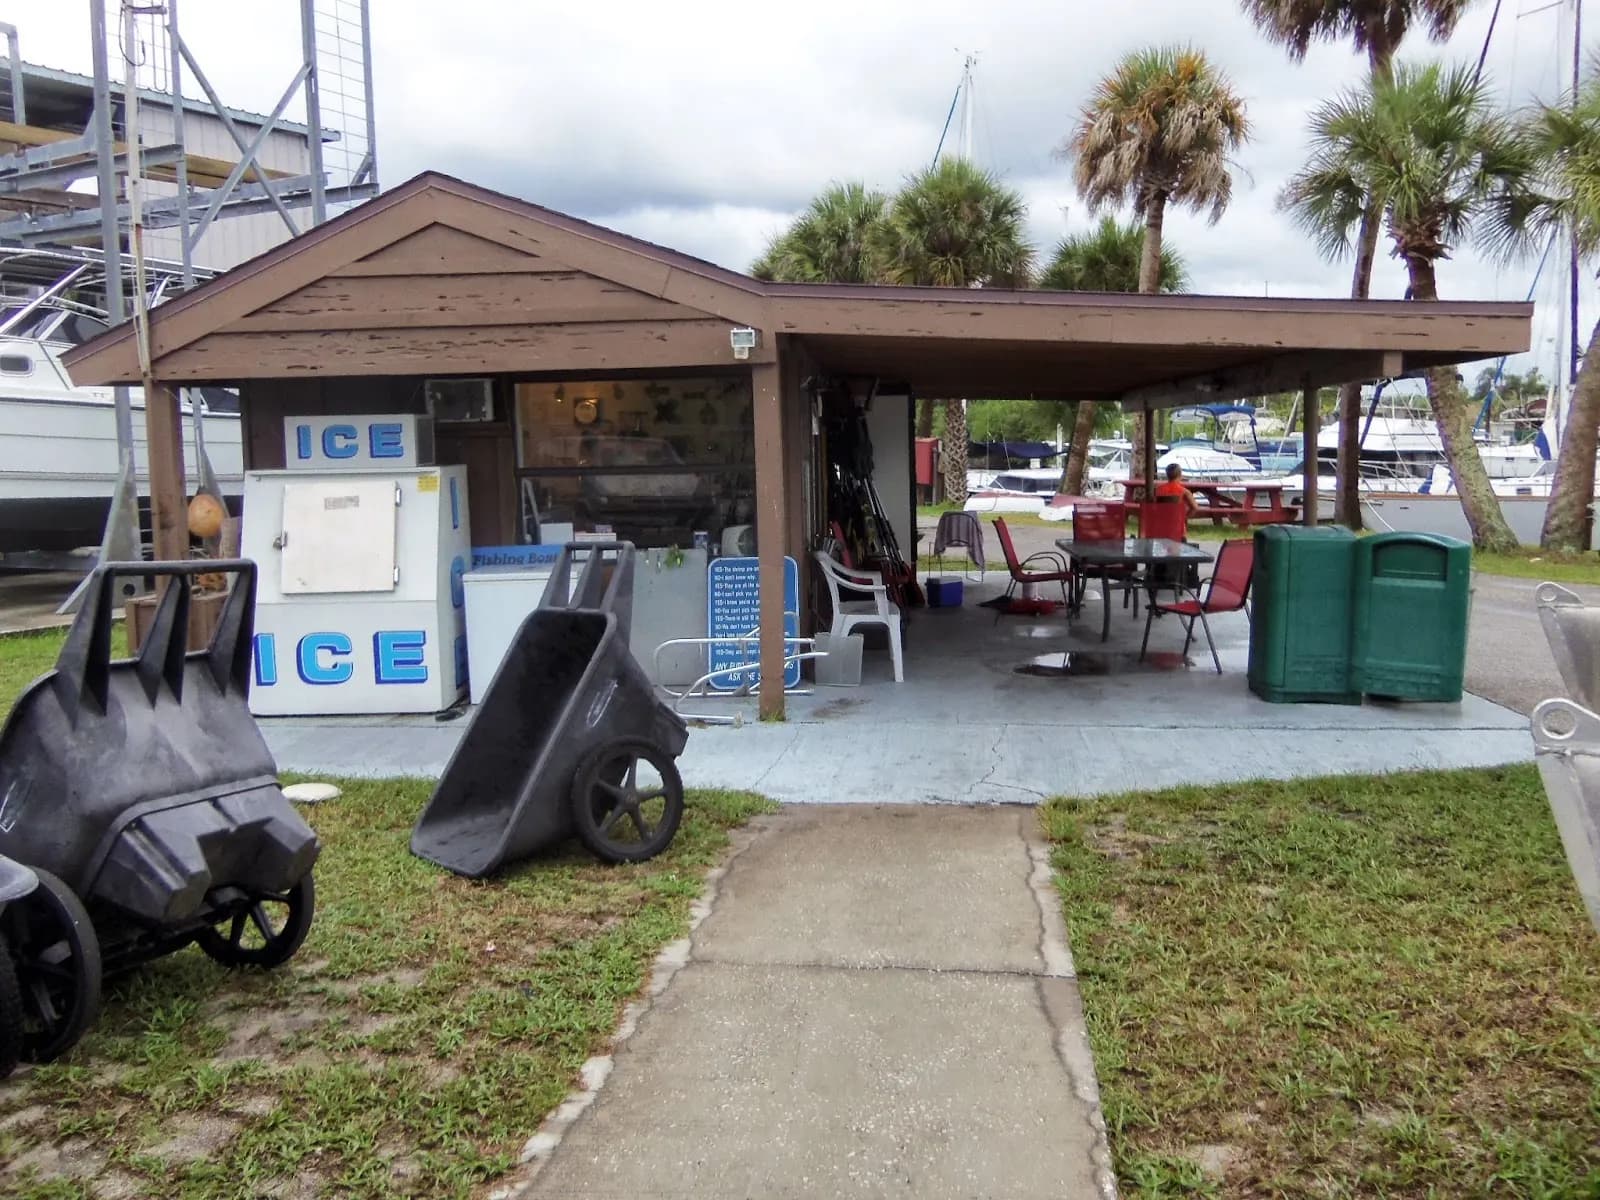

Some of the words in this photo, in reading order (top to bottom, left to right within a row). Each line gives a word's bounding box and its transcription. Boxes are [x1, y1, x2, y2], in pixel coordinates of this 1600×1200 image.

[297, 423, 404, 459] ICE
[254, 630, 428, 686] ICE
[727, 673, 742, 681] ASK
